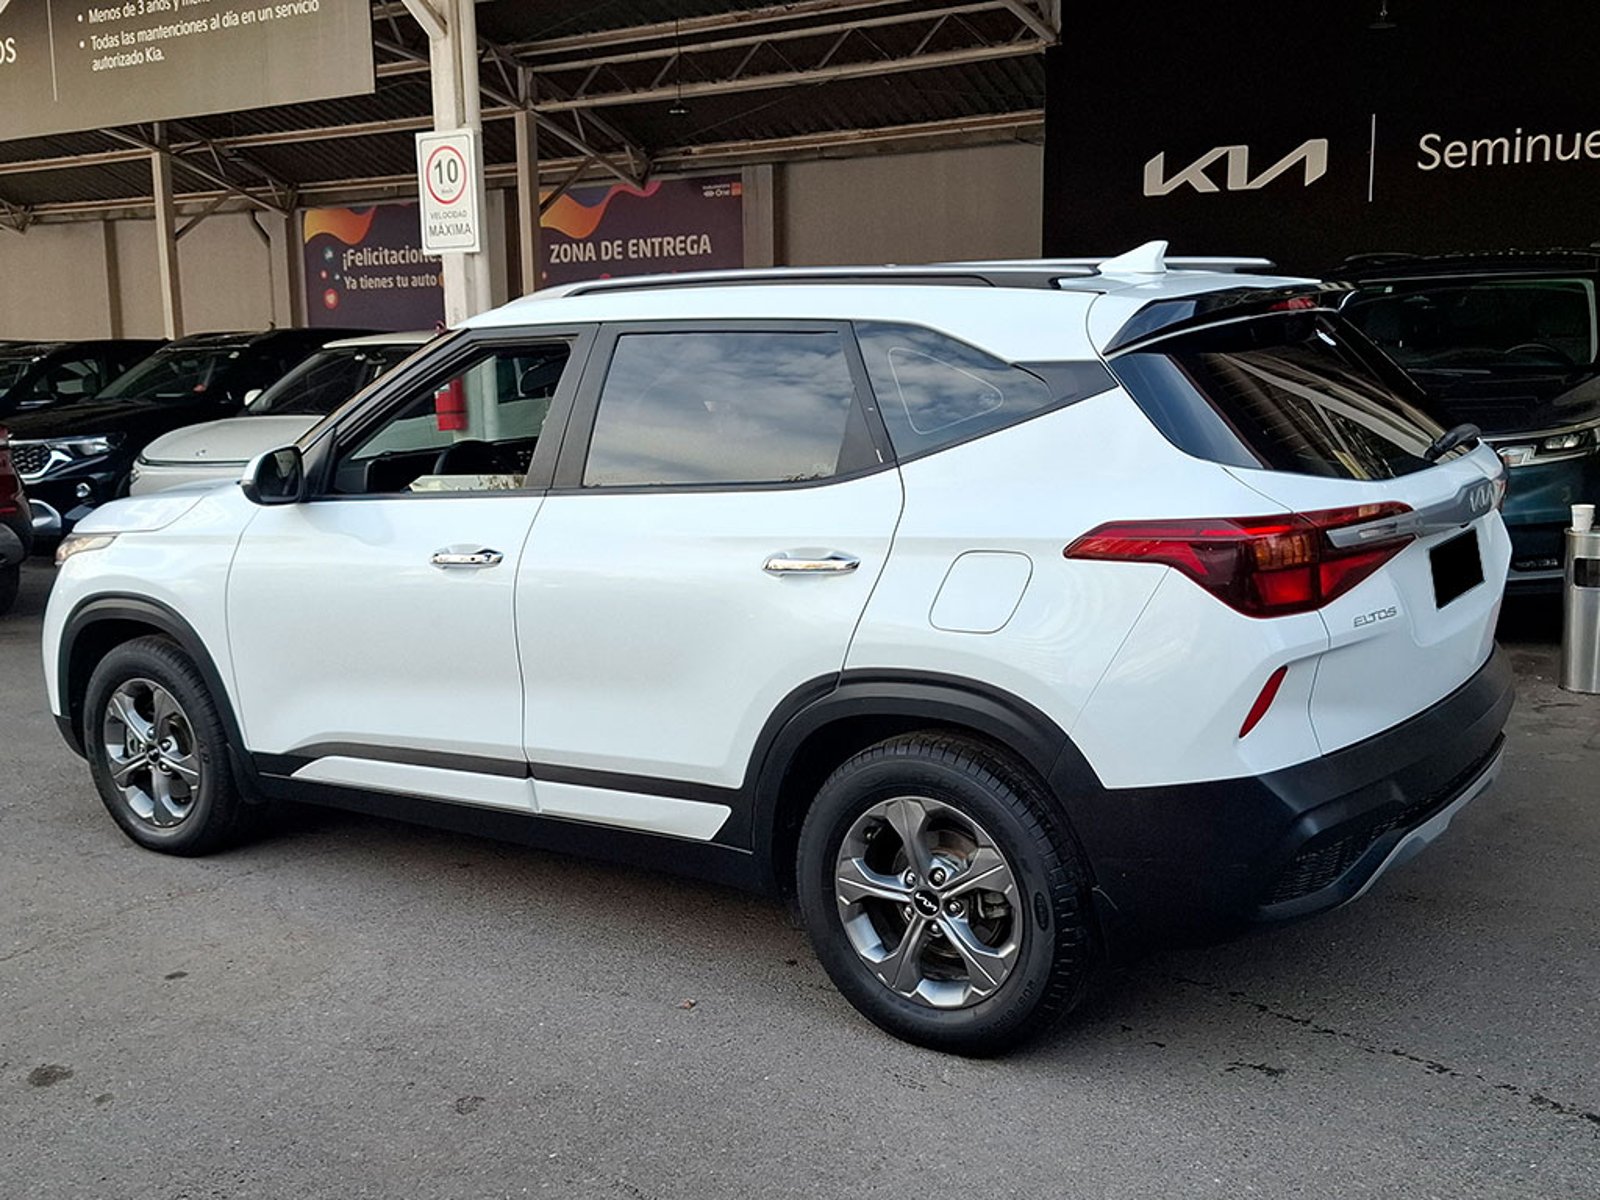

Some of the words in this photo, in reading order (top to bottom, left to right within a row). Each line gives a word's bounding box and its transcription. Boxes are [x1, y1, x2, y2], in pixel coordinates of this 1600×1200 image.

[88, 7, 121, 24] Menos
[122, 2, 136, 18] de
[137, 0, 145, 15] 3
[90, 32, 120, 51] Todas
[121, 29, 136, 45] las
[137, 19, 208, 42] mantenciones
[210, 13, 220, 30] al
[222, 10, 240, 28] día
[241, 10, 256, 24] en
[257, 6, 274, 22] un
[275, 0, 320, 19] servicio
[92, 49, 145, 72] autorizado
[145, 46, 165, 63] Kia.
[434, 158, 459, 185] 10
[1143, 138, 1328, 197] KIA
[429, 209, 468, 219] VELOCIDAD
[550, 242, 597, 264] ZONA
[601, 240, 624, 261] DE
[628, 234, 712, 259] ENTREGA
[343, 276, 358, 290] Ya
[360, 274, 395, 290] tienes
[396, 274, 409, 288] tu
[410, 273, 437, 288] auto
